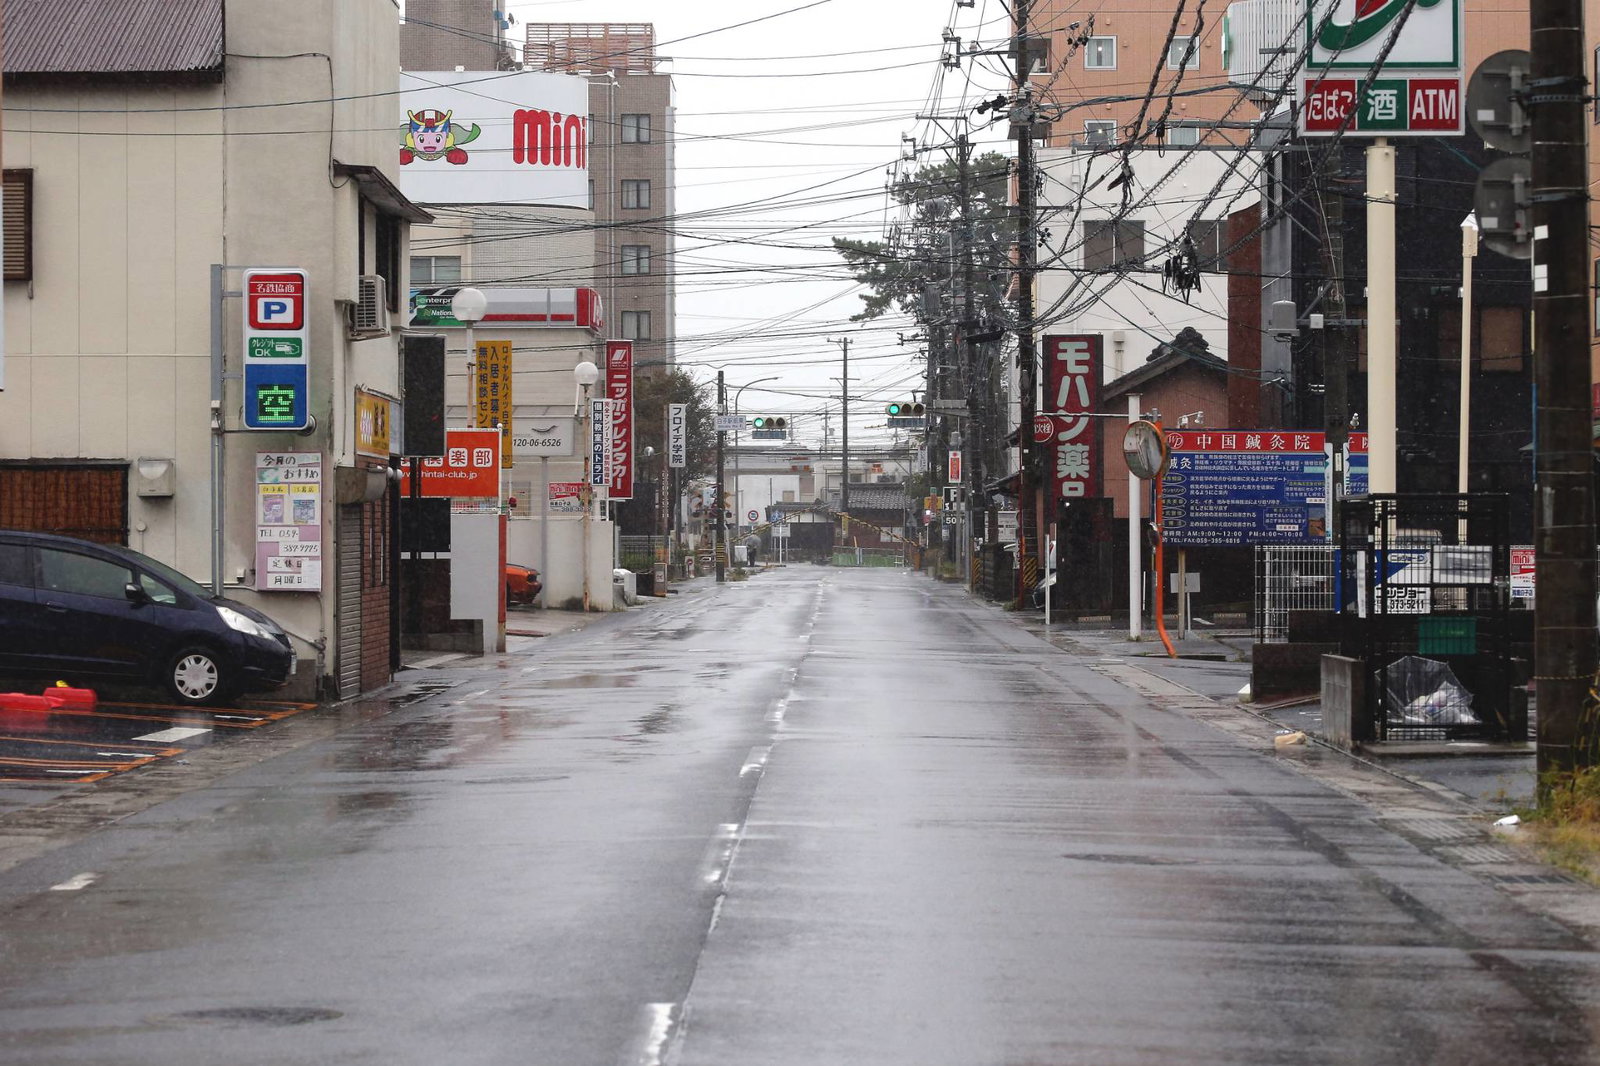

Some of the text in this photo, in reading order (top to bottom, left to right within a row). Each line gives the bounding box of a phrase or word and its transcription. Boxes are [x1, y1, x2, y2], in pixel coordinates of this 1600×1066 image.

[1307, 89, 1354, 120] たばこ
[1367, 89, 1397, 120] 酒
[1412, 89, 1456, 120] ATM
[513, 108, 586, 170] mini
[256, 283, 295, 293] 名鉄協商
[263, 301, 287, 320] P
[251, 338, 275, 347] クレジット
[478, 346, 488, 428] 無料相談セン
[259, 385, 294, 422] 空
[593, 402, 603, 484] 個別教室のトライ
[610, 374, 628, 490] ニッポンレンタカー
[673, 407, 683, 464] フロイデ学院
[1034, 423, 1051, 434] 火栓
[1197, 434, 1310, 450] 中国鍼灸院
[263, 454, 296, 466] 今月の
[274, 576, 303, 585] 月曜日
